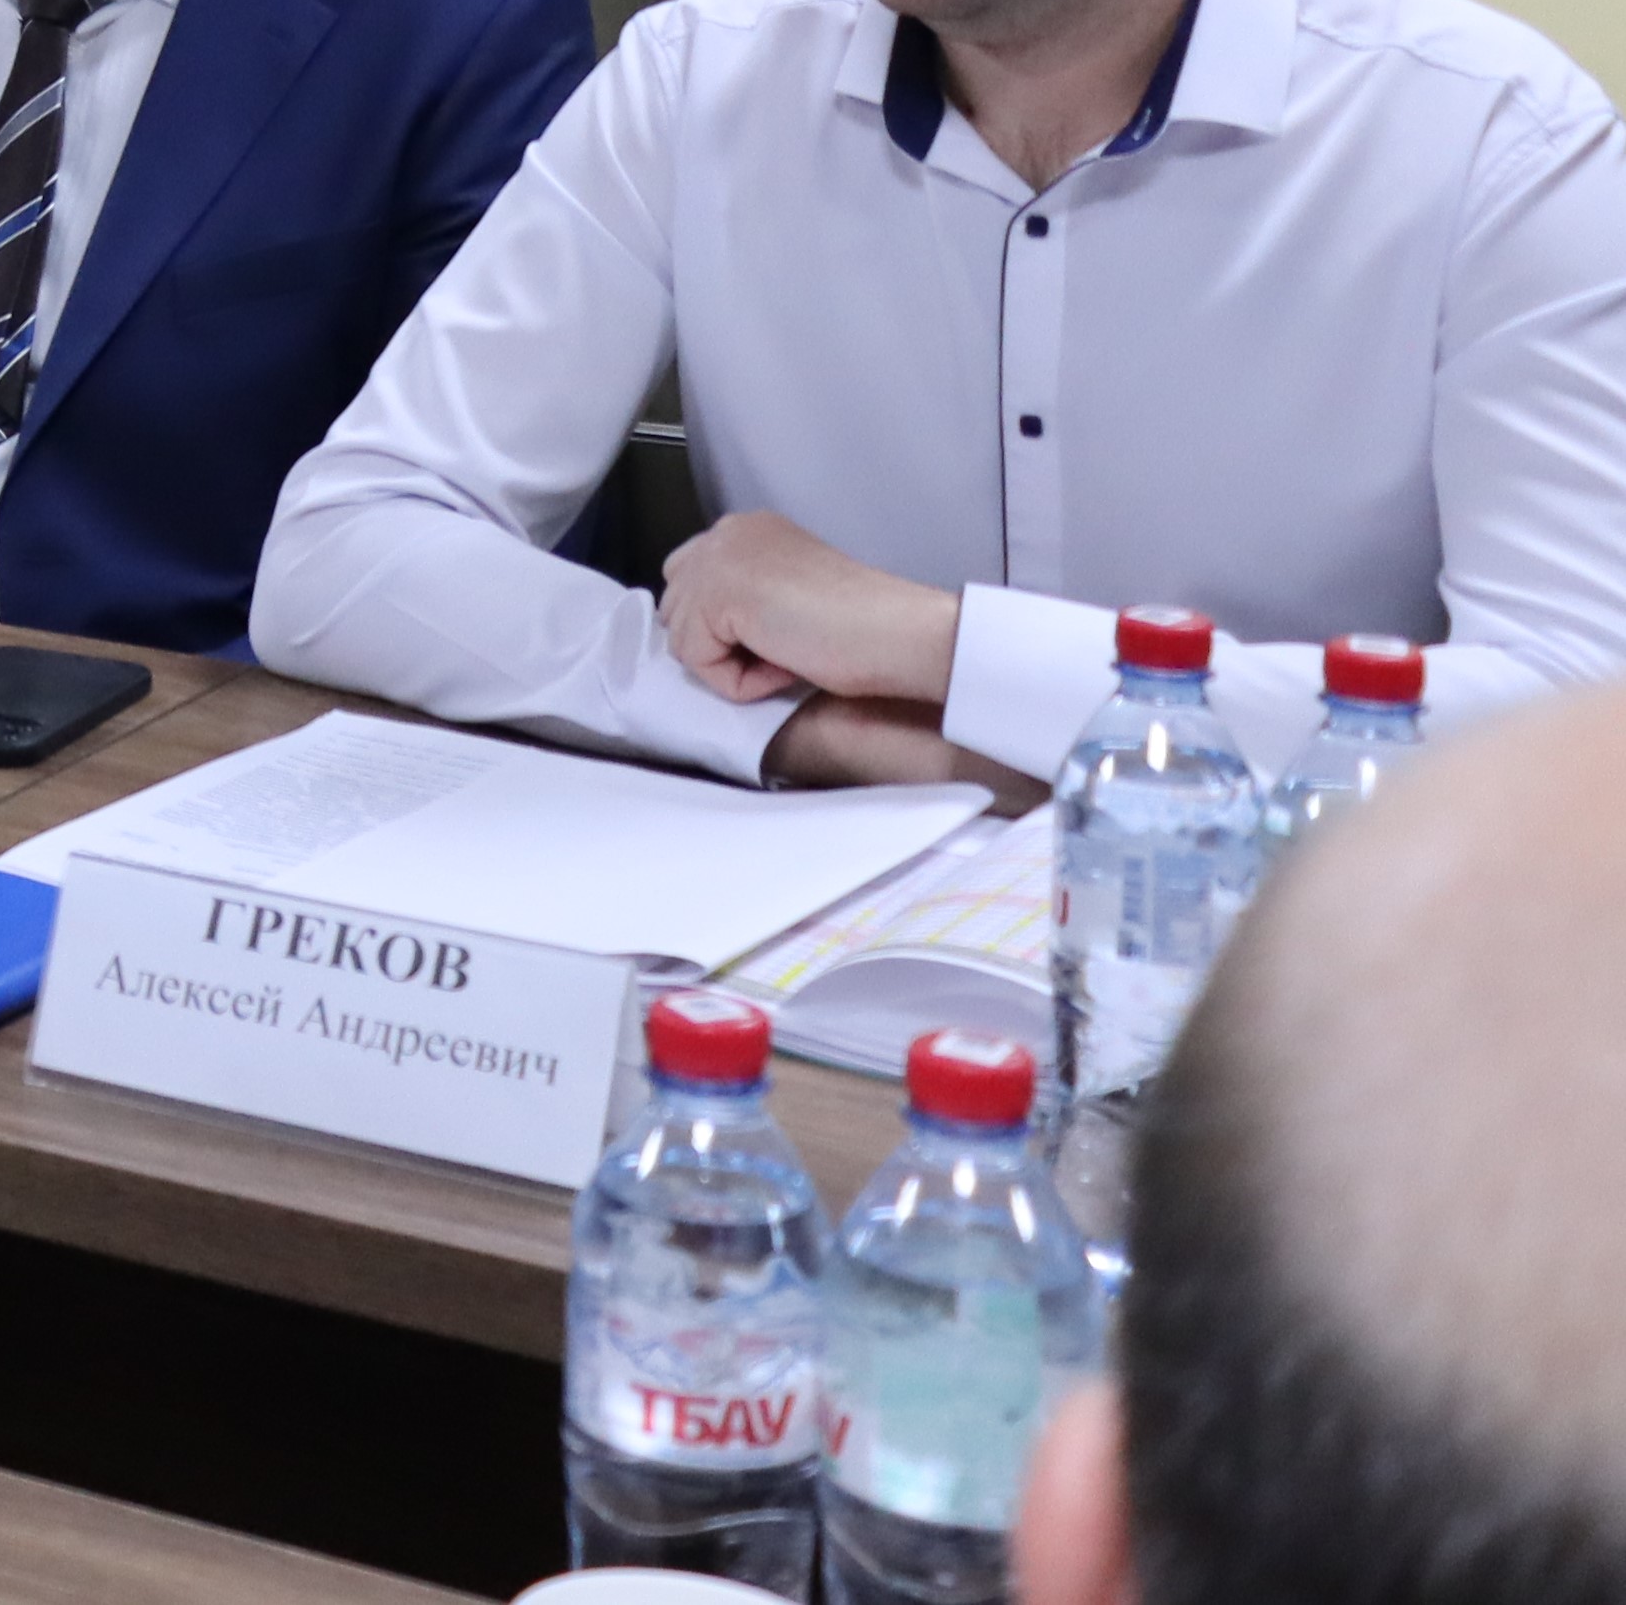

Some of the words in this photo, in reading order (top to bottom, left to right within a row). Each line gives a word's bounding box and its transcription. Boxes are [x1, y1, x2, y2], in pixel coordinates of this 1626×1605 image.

[201, 895, 474, 995] ГРЕКОВ
[94, 953, 284, 1030] Алексей
[296, 996, 560, 1088] Андреевич
[631, 1381, 797, 1447] ТБАУ
